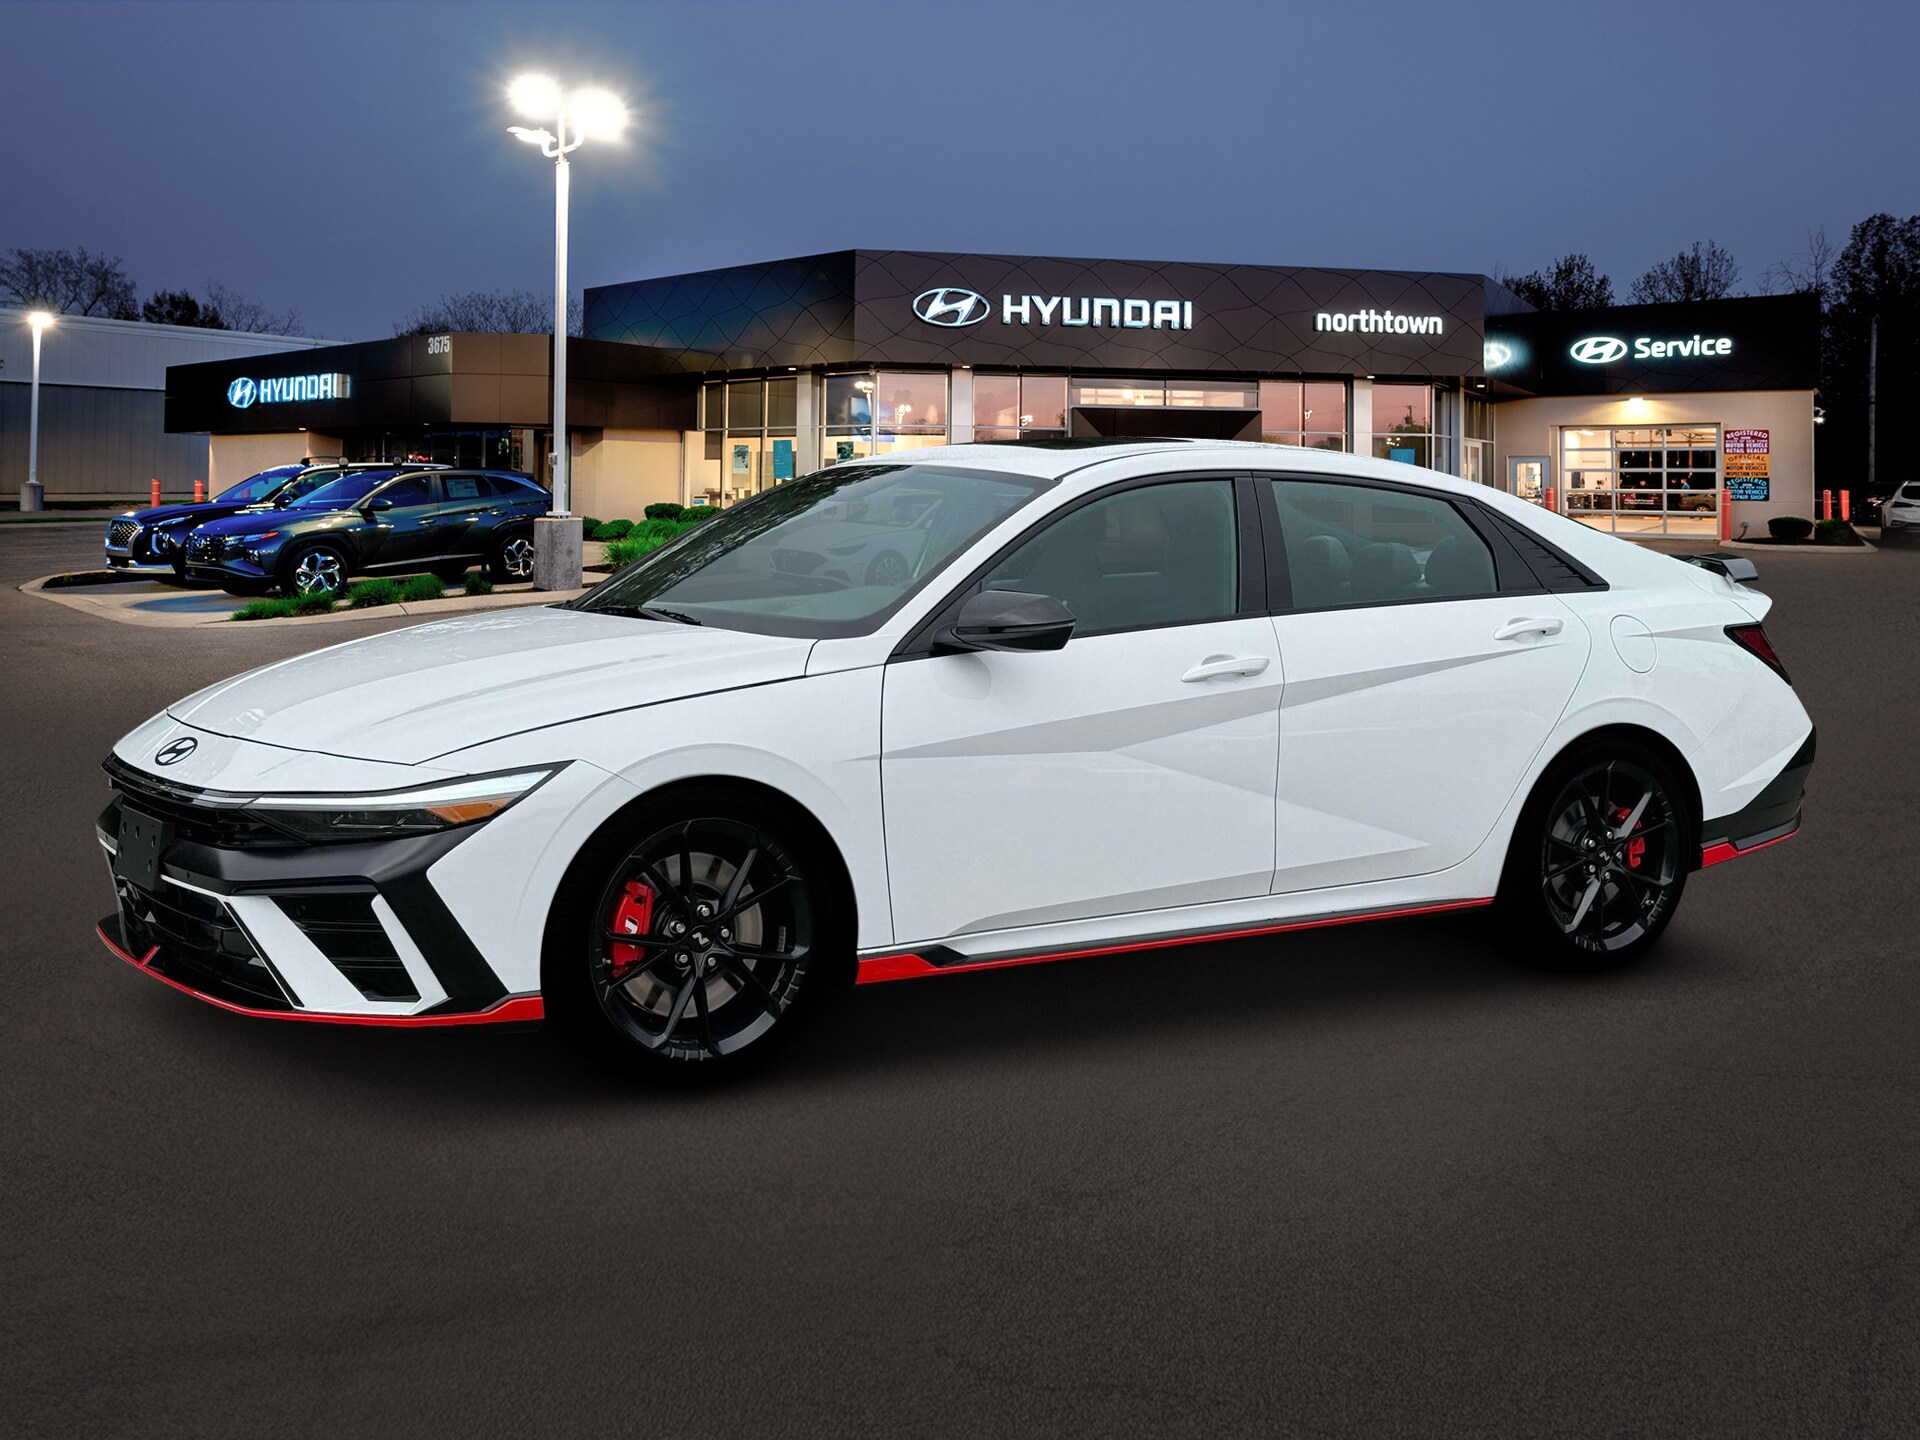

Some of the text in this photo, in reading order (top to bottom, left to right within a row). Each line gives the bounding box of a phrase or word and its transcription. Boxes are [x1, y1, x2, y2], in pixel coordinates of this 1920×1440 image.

[1002, 294, 1193, 330] HYUNDAI
[1316, 309, 1443, 335] northtown
[428, 335, 450, 354] 3675
[1634, 335, 1732, 358] Service
[260, 373, 341, 403] HYUNDAI
[1726, 430, 1768, 439] REGISTERED
[1728, 454, 1766, 462] OFFICIAL
[1726, 477, 1767, 486] REGISTERED
